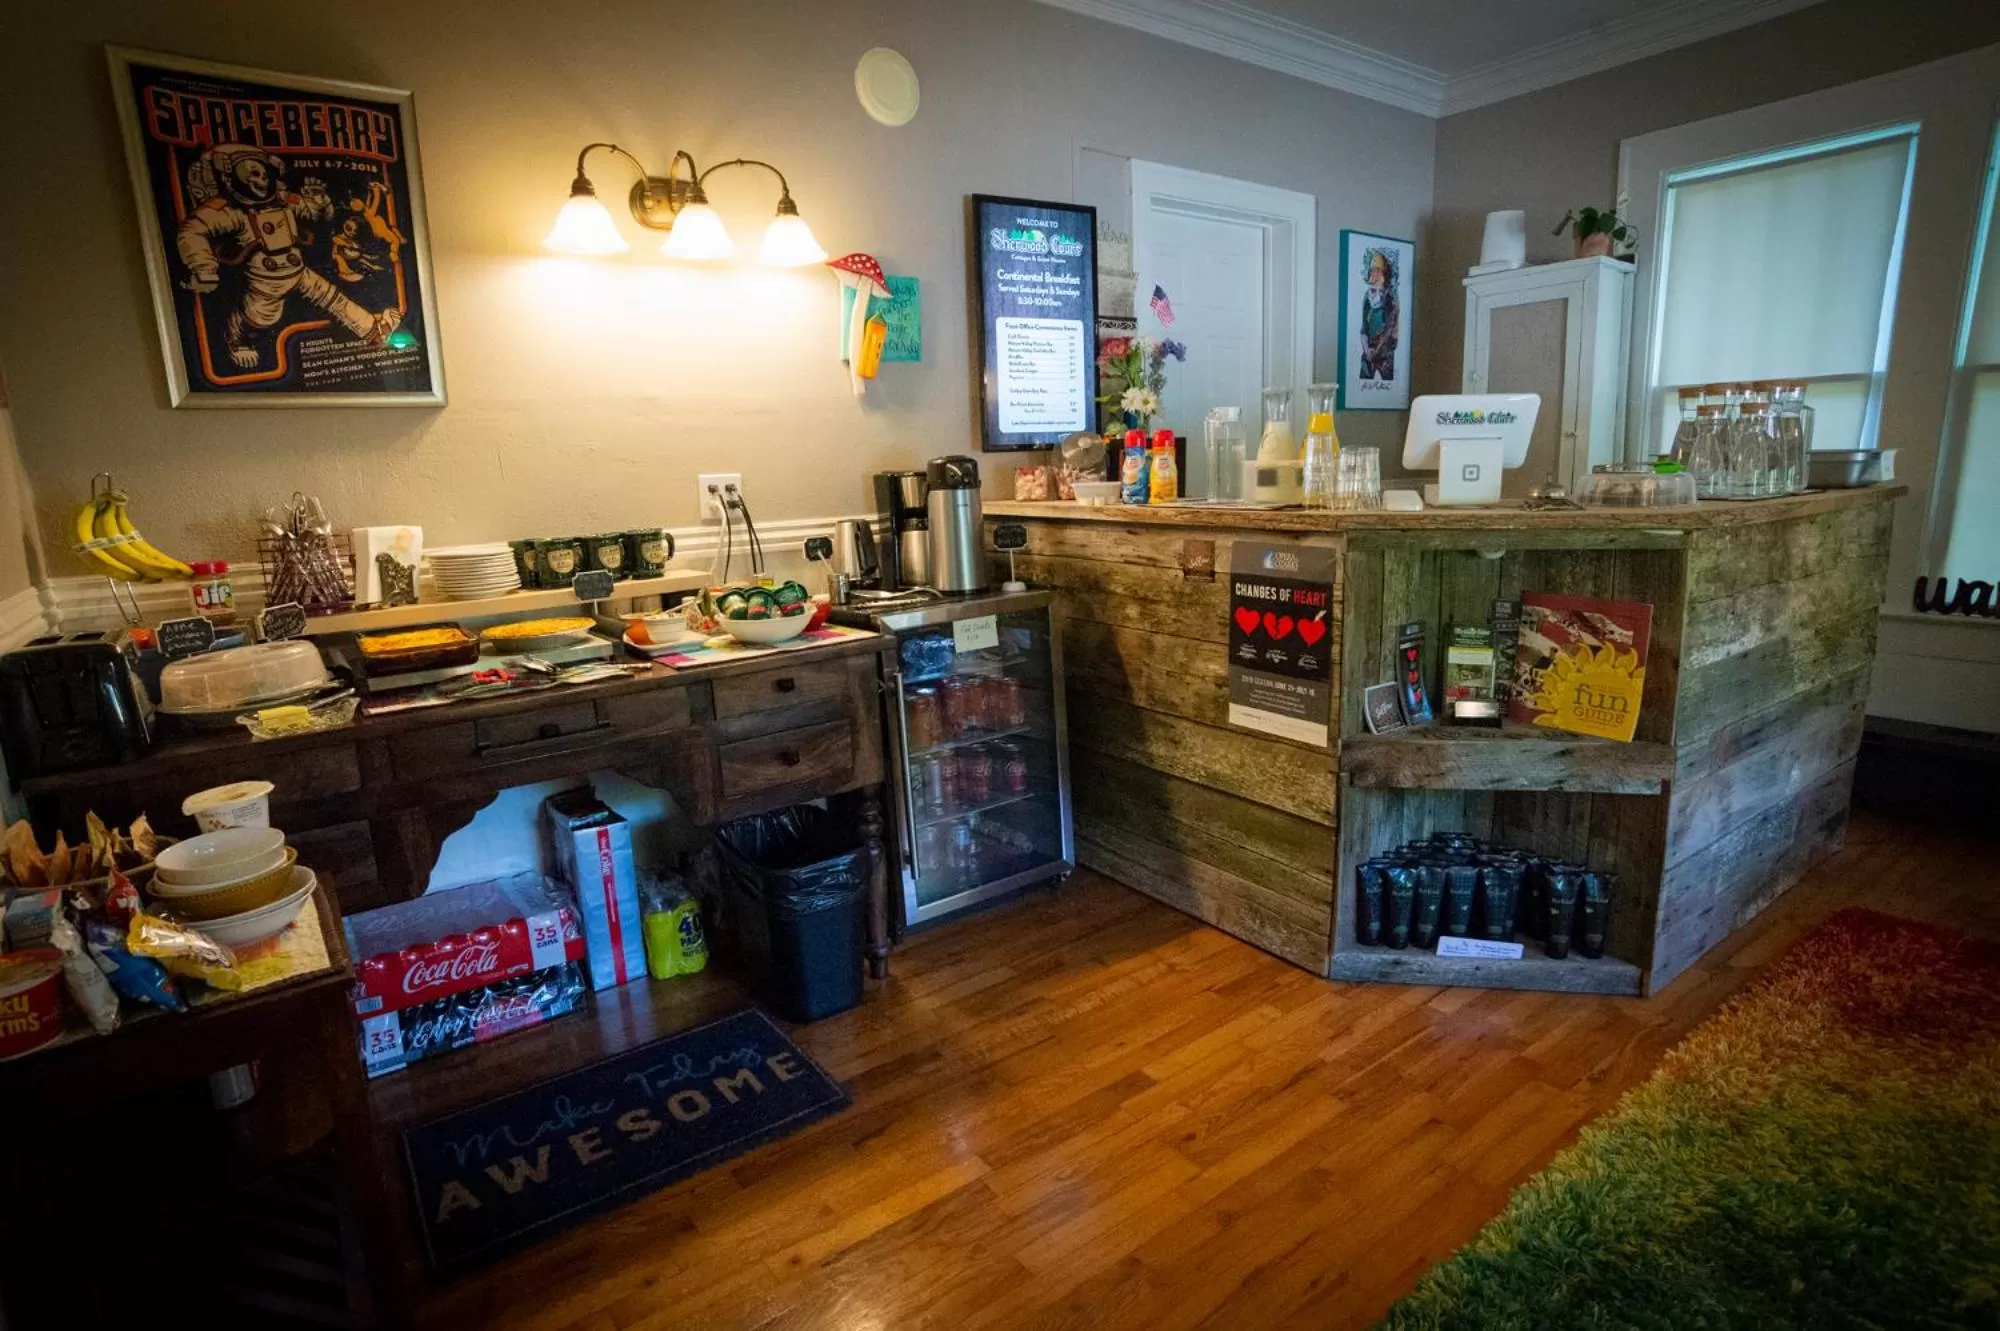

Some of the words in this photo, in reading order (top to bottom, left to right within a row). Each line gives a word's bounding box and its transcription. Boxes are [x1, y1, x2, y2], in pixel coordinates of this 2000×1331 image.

[145, 85, 398, 162] SPACEBERRY
[293, 159, 320, 169] JULY
[1016, 217, 1048, 228] WELCOME
[1050, 220, 1059, 229] TO
[990, 227, 1049, 255] Sherwood
[997, 268, 1043, 282] Continental
[1045, 271, 1080, 285] Breakfast
[998, 283, 1019, 293] Served
[1019, 284, 1048, 297] Saturdays
[1056, 287, 1080, 299] Sundays
[300, 343, 344, 354] FORGOTTEN
[345, 339, 368, 348] SPACE
[302, 359, 322, 369] SEAN
[331, 364, 364, 375] KITCHEN
[374, 359, 393, 368] WHO
[394, 355, 421, 364] KNOWS
[1235, 581, 1277, 601] CHANGES
[1279, 587, 1292, 603] OF
[1292, 588, 1329, 608] HEART
[1572, 682, 1631, 714] fun
[1573, 706, 1625, 724] GUIDE
[534, 924, 557, 942] 35
[401, 940, 501, 994] Coca-Cola
[370, 1029, 396, 1047] 35
[435, 1051, 803, 1225] AWESOME
[444, 1095, 616, 1167] Make
